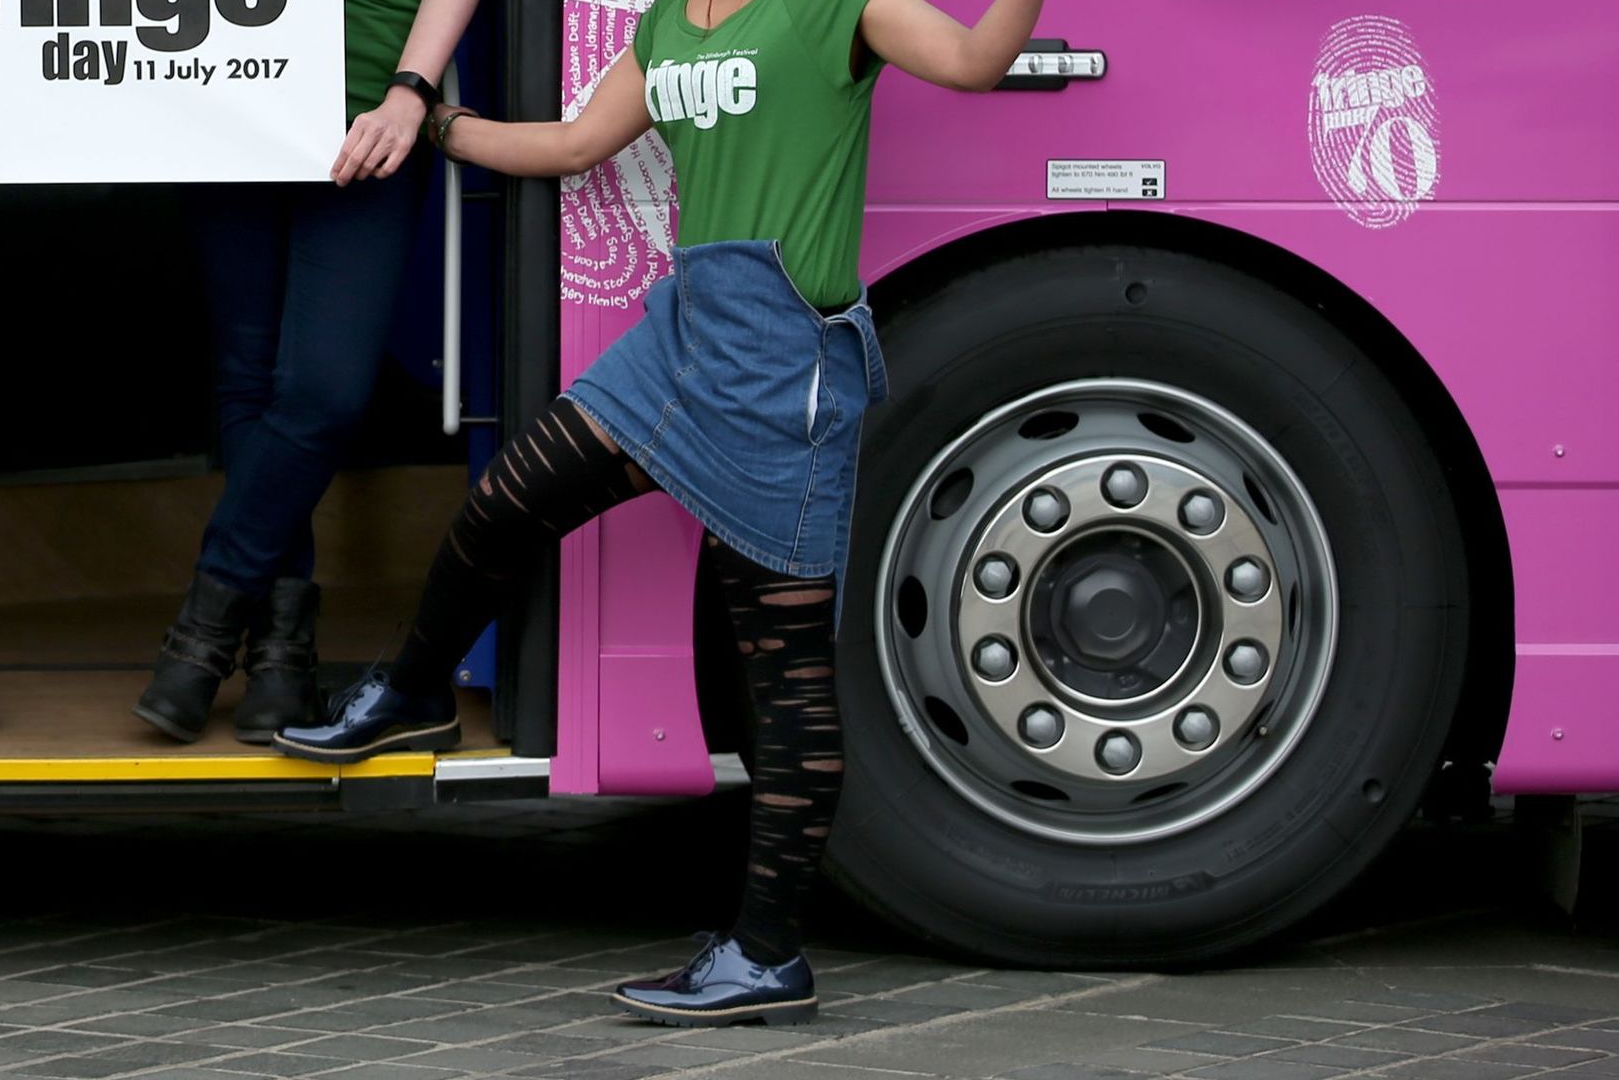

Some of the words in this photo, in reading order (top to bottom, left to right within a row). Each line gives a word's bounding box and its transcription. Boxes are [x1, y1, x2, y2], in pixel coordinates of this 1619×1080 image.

[568, 12, 580, 41] Delft
[42, 32, 128, 85] day
[133, 60, 156, 81] 11
[164, 57, 217, 85] July
[227, 58, 289, 80] 2017
[569, 45, 581, 95] Brisbane
[732, 48, 758, 56] Festival
[645, 57, 756, 129] ringe
[1313, 65, 1426, 112] fringe
[1323, 103, 1437, 201] 70
[638, 160, 666, 222] Greensboro
[577, 206, 597, 240] Dublin
[610, 204, 634, 242] Sydney
[561, 265, 601, 288] henzhen
[603, 242, 637, 290] Stockholm
[589, 294, 628, 309] Henley
